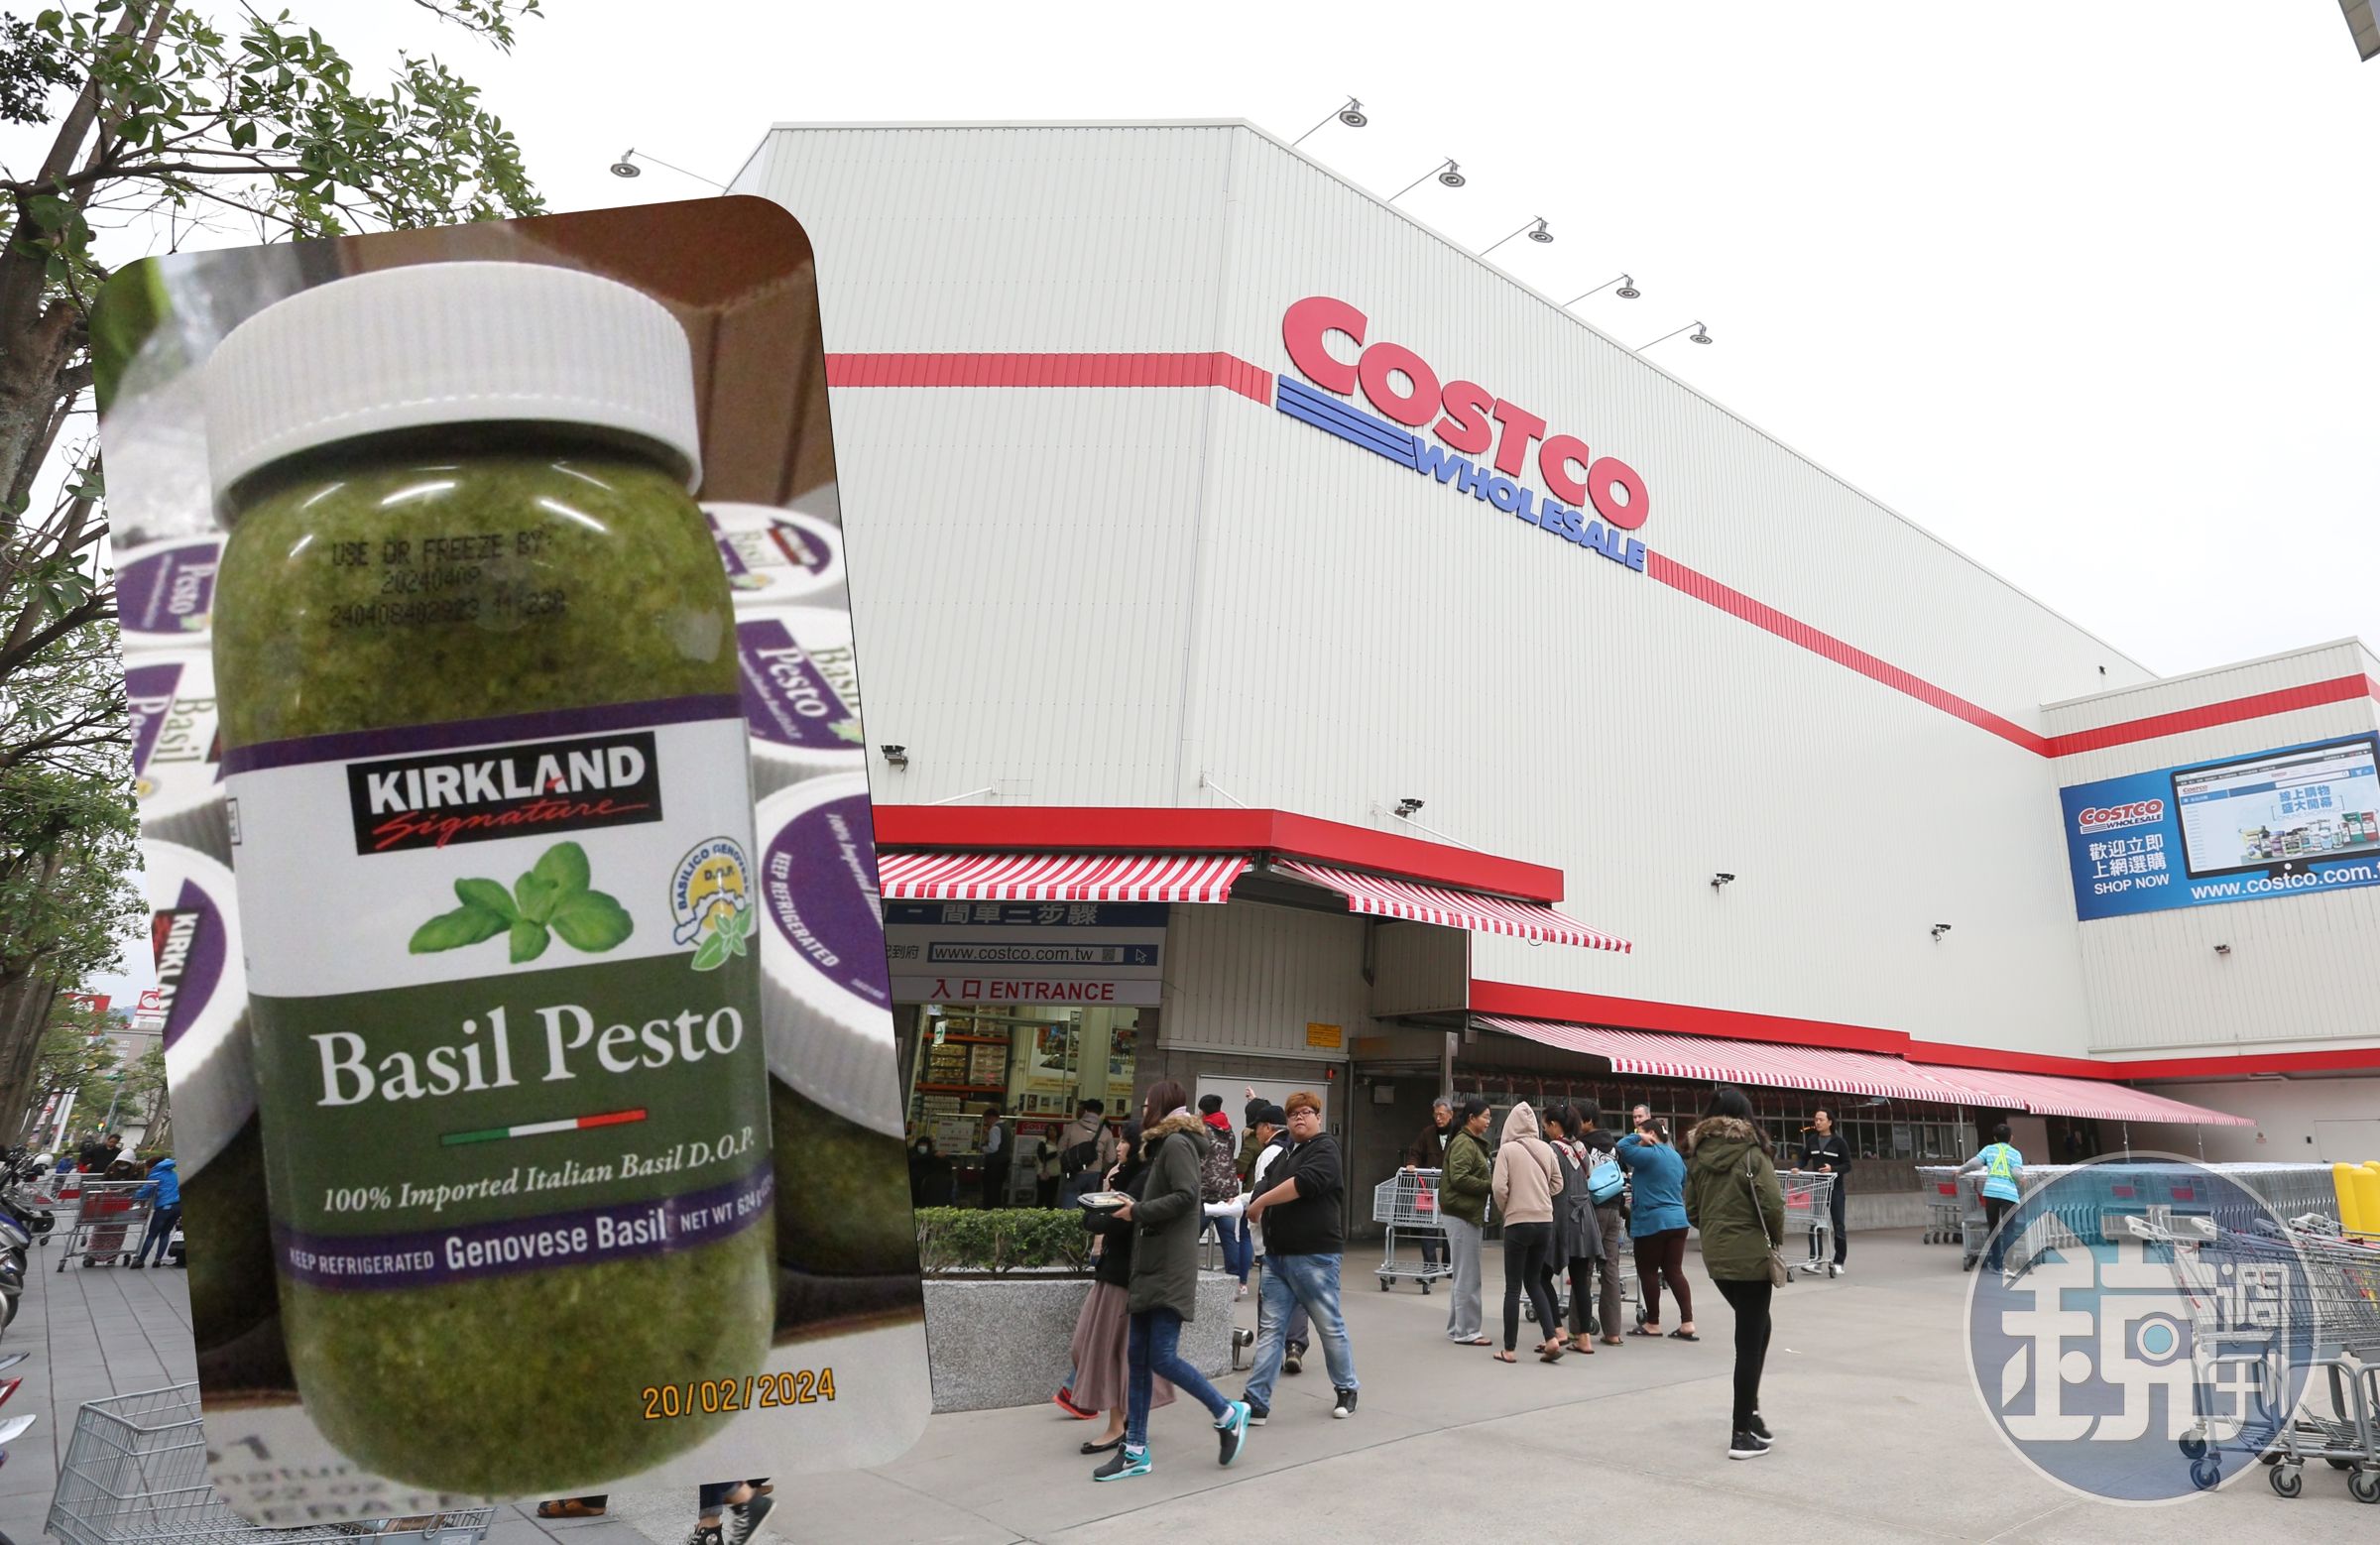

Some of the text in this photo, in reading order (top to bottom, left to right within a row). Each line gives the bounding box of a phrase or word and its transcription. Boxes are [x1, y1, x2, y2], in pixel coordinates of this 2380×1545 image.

[1282, 296, 1649, 531] COSTCO
[1411, 434, 1646, 572] WHOLESALE
[332, 541, 369, 566] USE
[383, 539, 412, 565] OR
[422, 534, 504, 564] FREEZE
[755, 648, 829, 718] Pesto
[151, 697, 216, 765] Basil
[367, 745, 646, 815] KIRKLAND
[372, 797, 650, 850] Signature
[2080, 799, 2164, 826] COSTCO
[2106, 813, 2163, 829] WHOLESALE
[2088, 833, 2164, 861] 歡迎立即
[2092, 852, 2167, 879] 上網選購
[677, 848, 710, 910] BASILICO
[2093, 874, 2170, 894] SHOP NOW
[770, 851, 840, 967] KEEP REFRIGERATED
[157, 912, 200, 1029] KIRKLAN
[935, 947, 1094, 962] www.costco.com.tw
[930, 979, 982, 999] 入口
[991, 982, 1116, 1001] ENTRANCE
[308, 1004, 744, 1107] Basil Pesto
[323, 1124, 756, 1212] 100% Imported Italian Basil D.O.P.
[445, 1207, 668, 1271] Genovese Basil
[680, 1209, 708, 1232] NET
[711, 1202, 732, 1225] WT
[289, 1248, 434, 1274] KEEP REFRIGERATED
